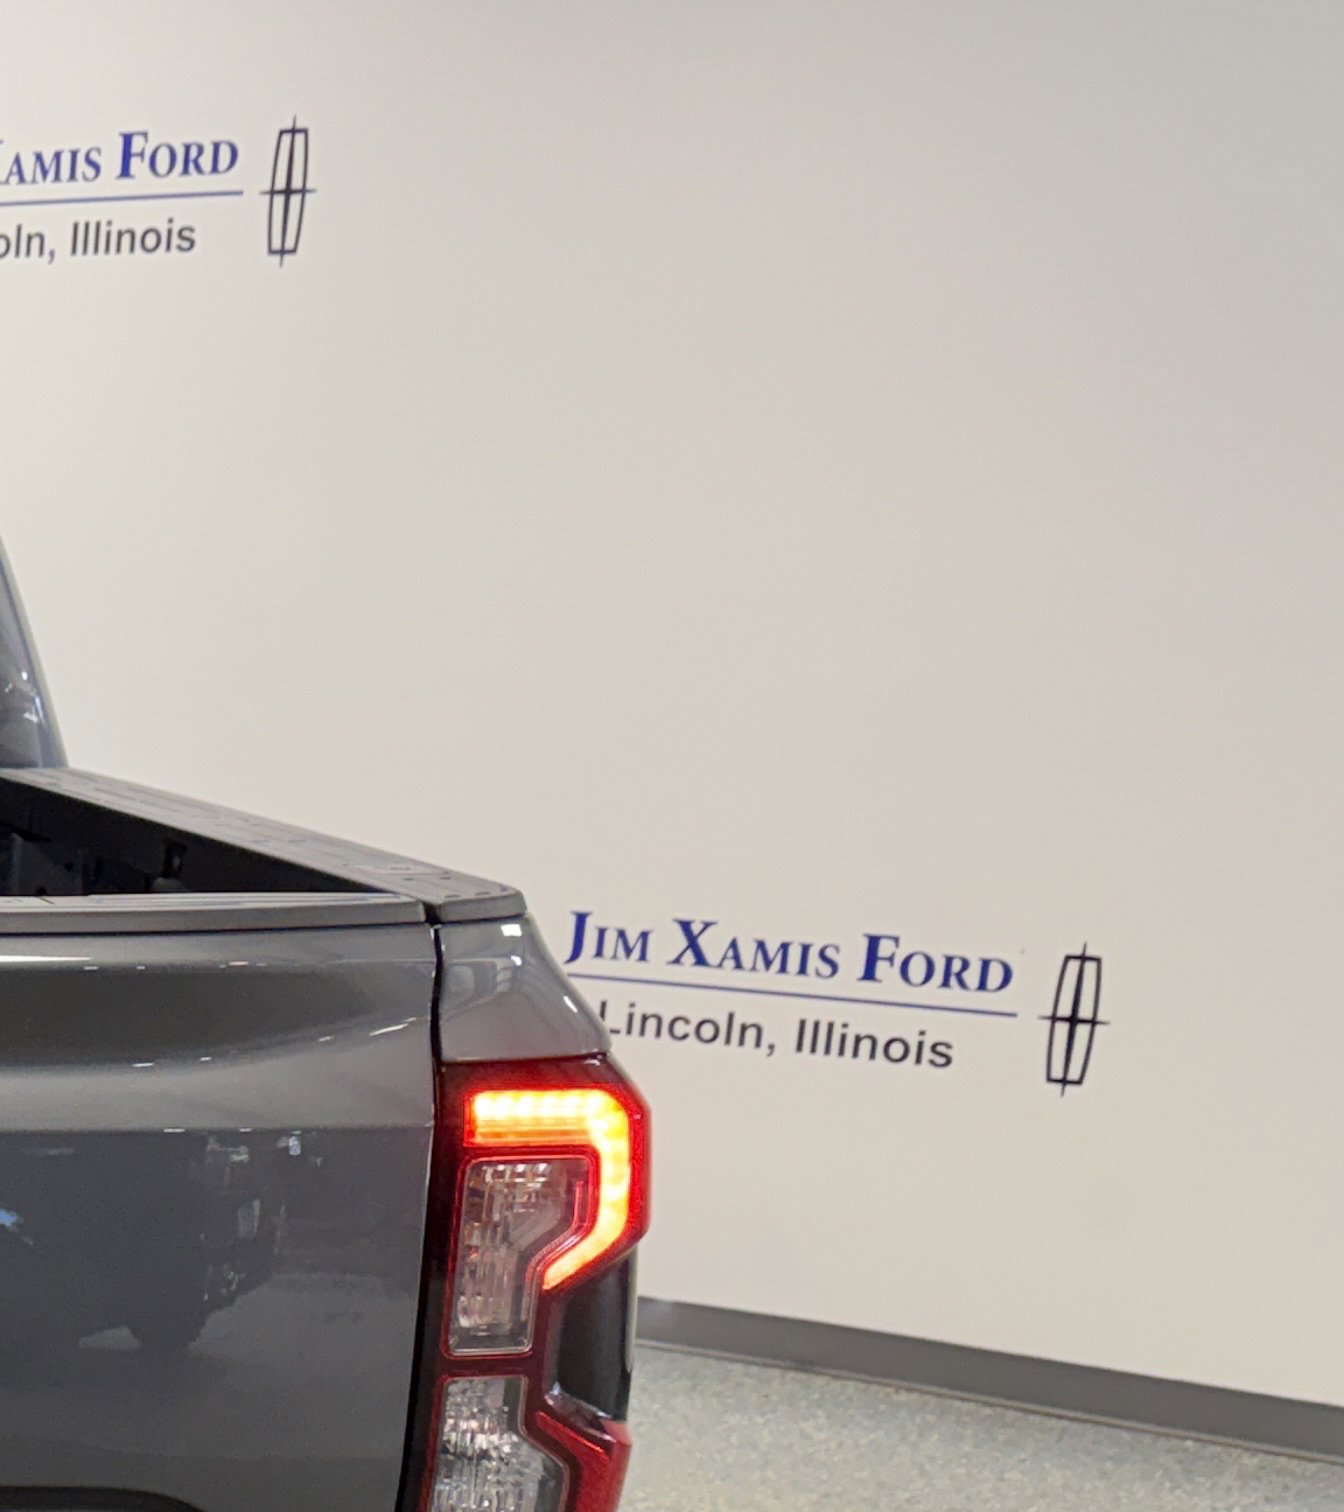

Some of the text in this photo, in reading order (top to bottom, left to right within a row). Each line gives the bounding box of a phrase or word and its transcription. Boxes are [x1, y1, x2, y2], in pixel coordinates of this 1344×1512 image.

[117, 130, 239, 181] FORD
[70, 217, 197, 257] Illinois
[563, 910, 1014, 994] JIM XAMIS FORD
[794, 1018, 955, 1070] Illinois
